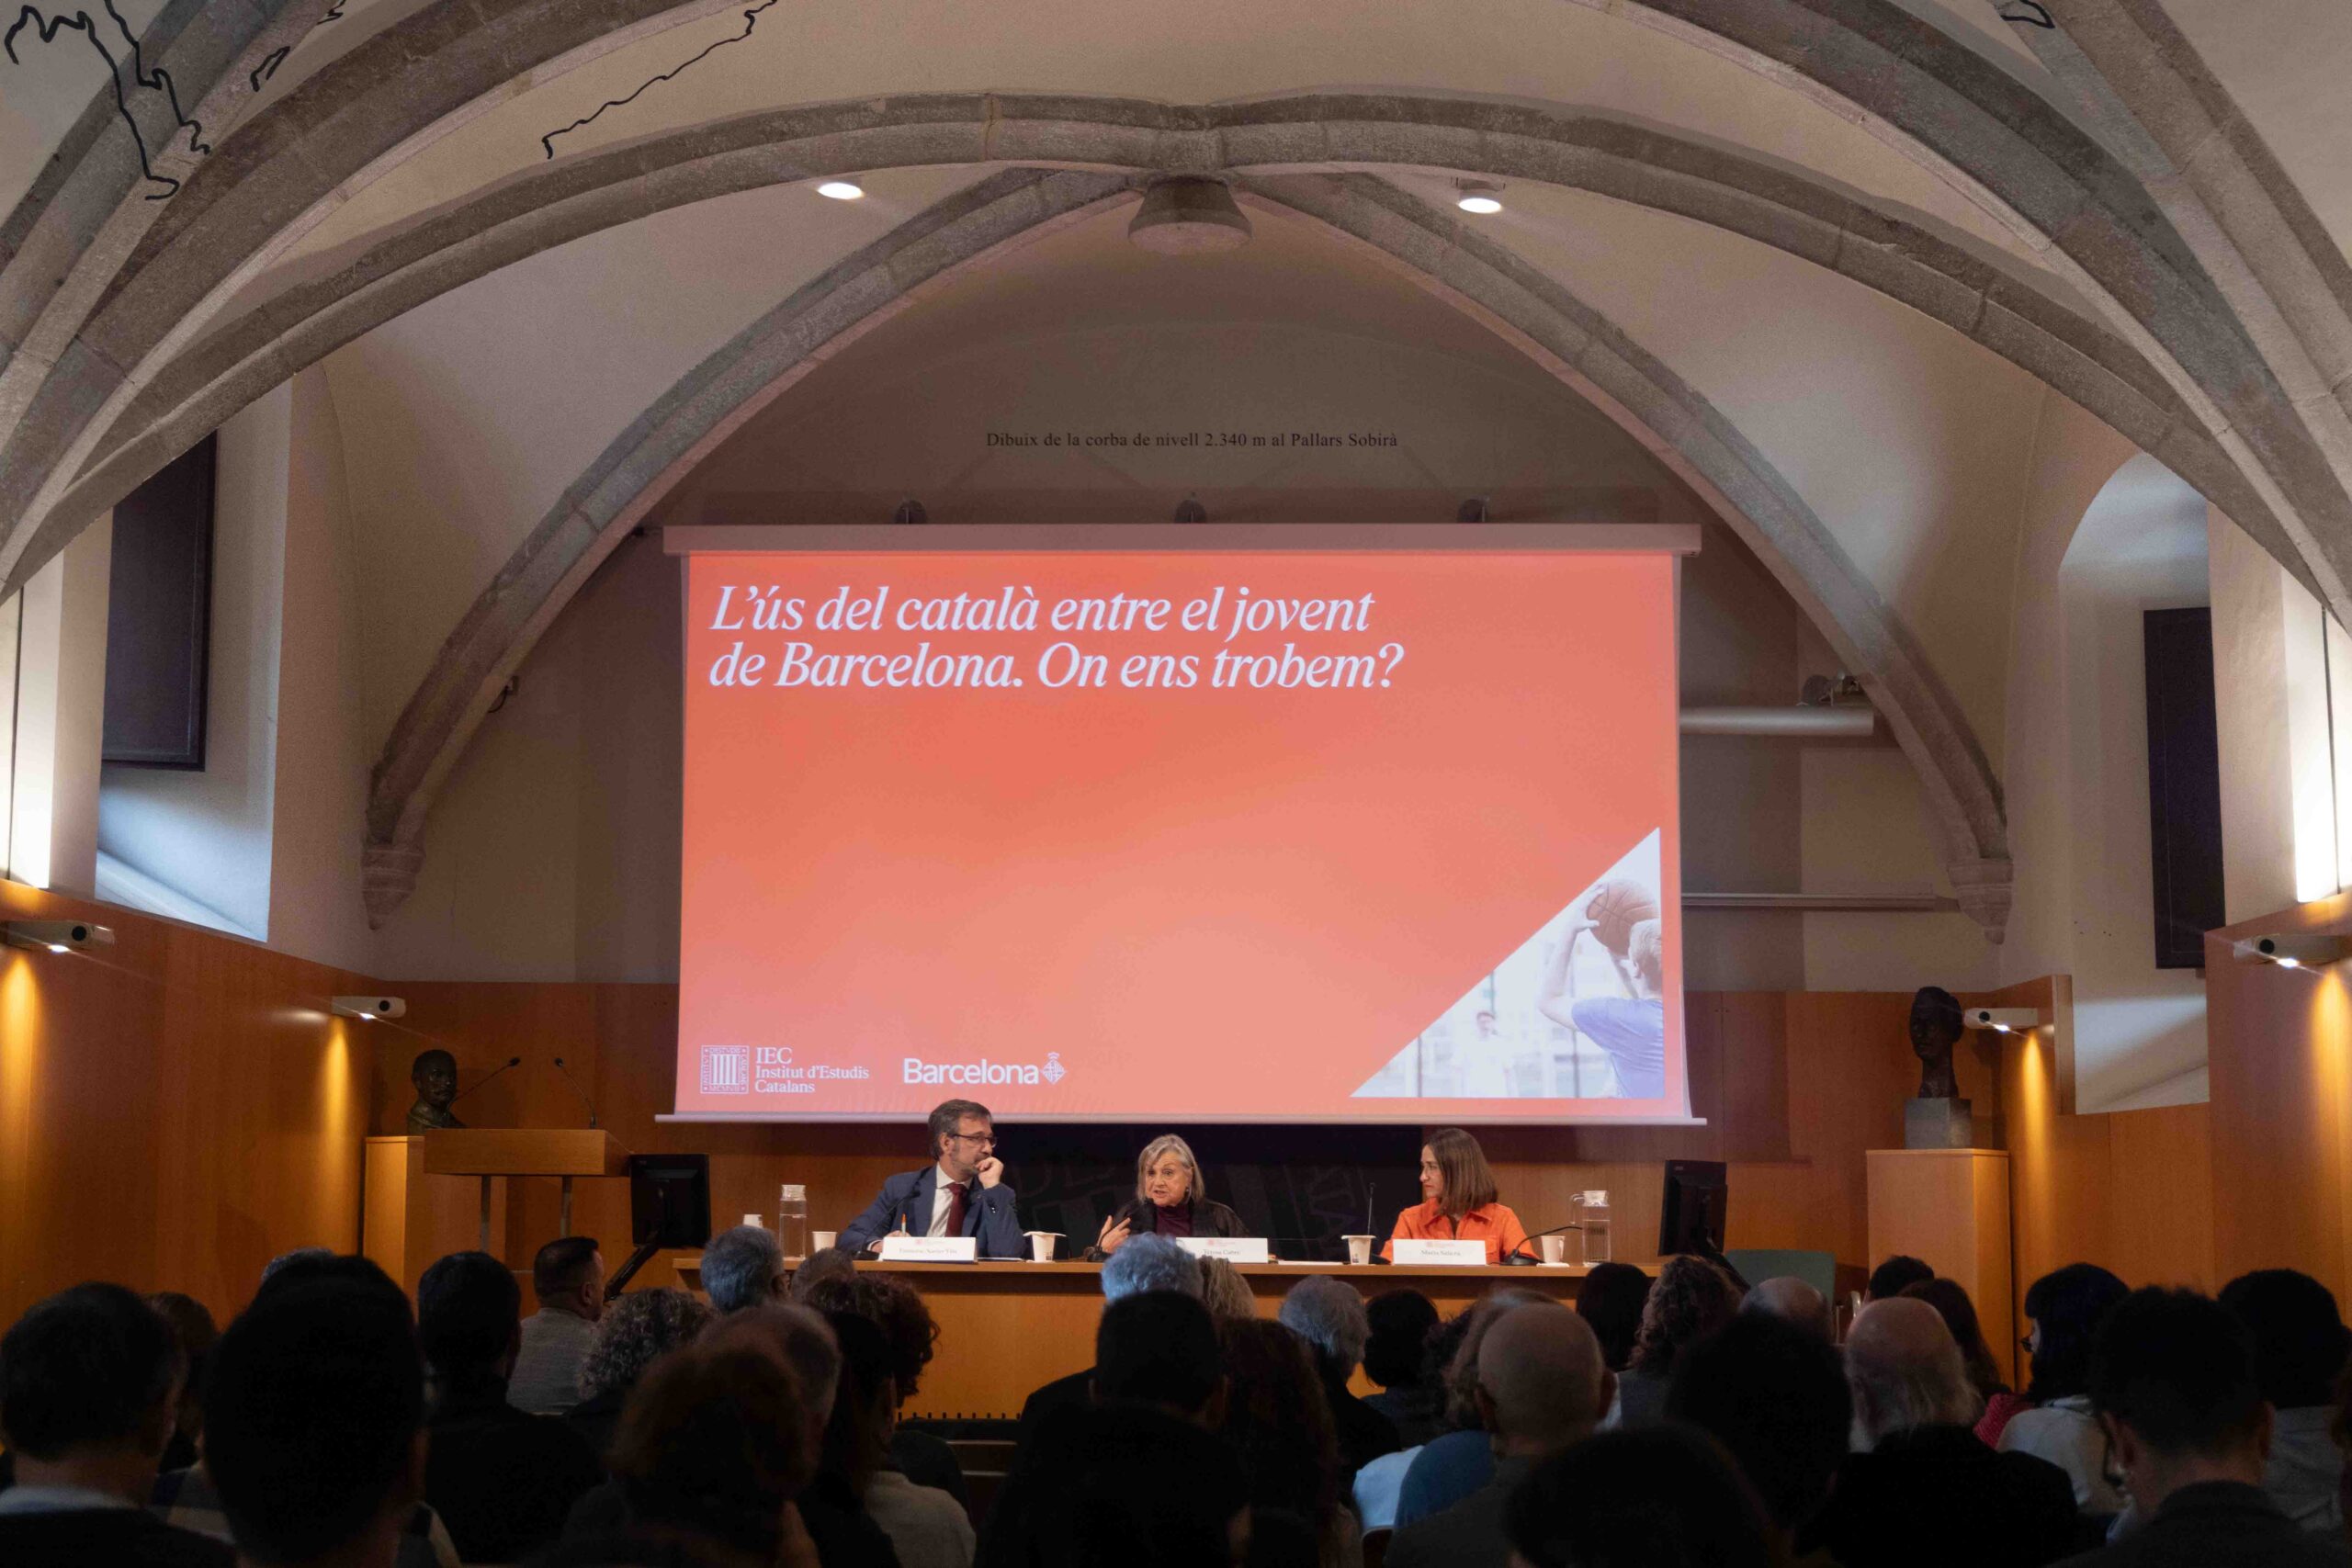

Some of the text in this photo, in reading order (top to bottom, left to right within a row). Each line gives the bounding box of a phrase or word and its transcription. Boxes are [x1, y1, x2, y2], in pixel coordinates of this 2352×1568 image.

[987, 432, 1397, 447] Dibuix de la corba de nivell 2.340 m al Pallars Sobirà
[710, 585, 1375, 643] L’ús del català entre el jovent
[709, 641, 1405, 688] de Barcelona. On ens trobem?
[756, 1046, 793, 1065] IEC
[755, 1065, 804, 1078] Institut
[807, 1065, 870, 1079] d'Estudis
[903, 1057, 1040, 1085] Barcelona
[754, 1079, 816, 1093] Catalans
